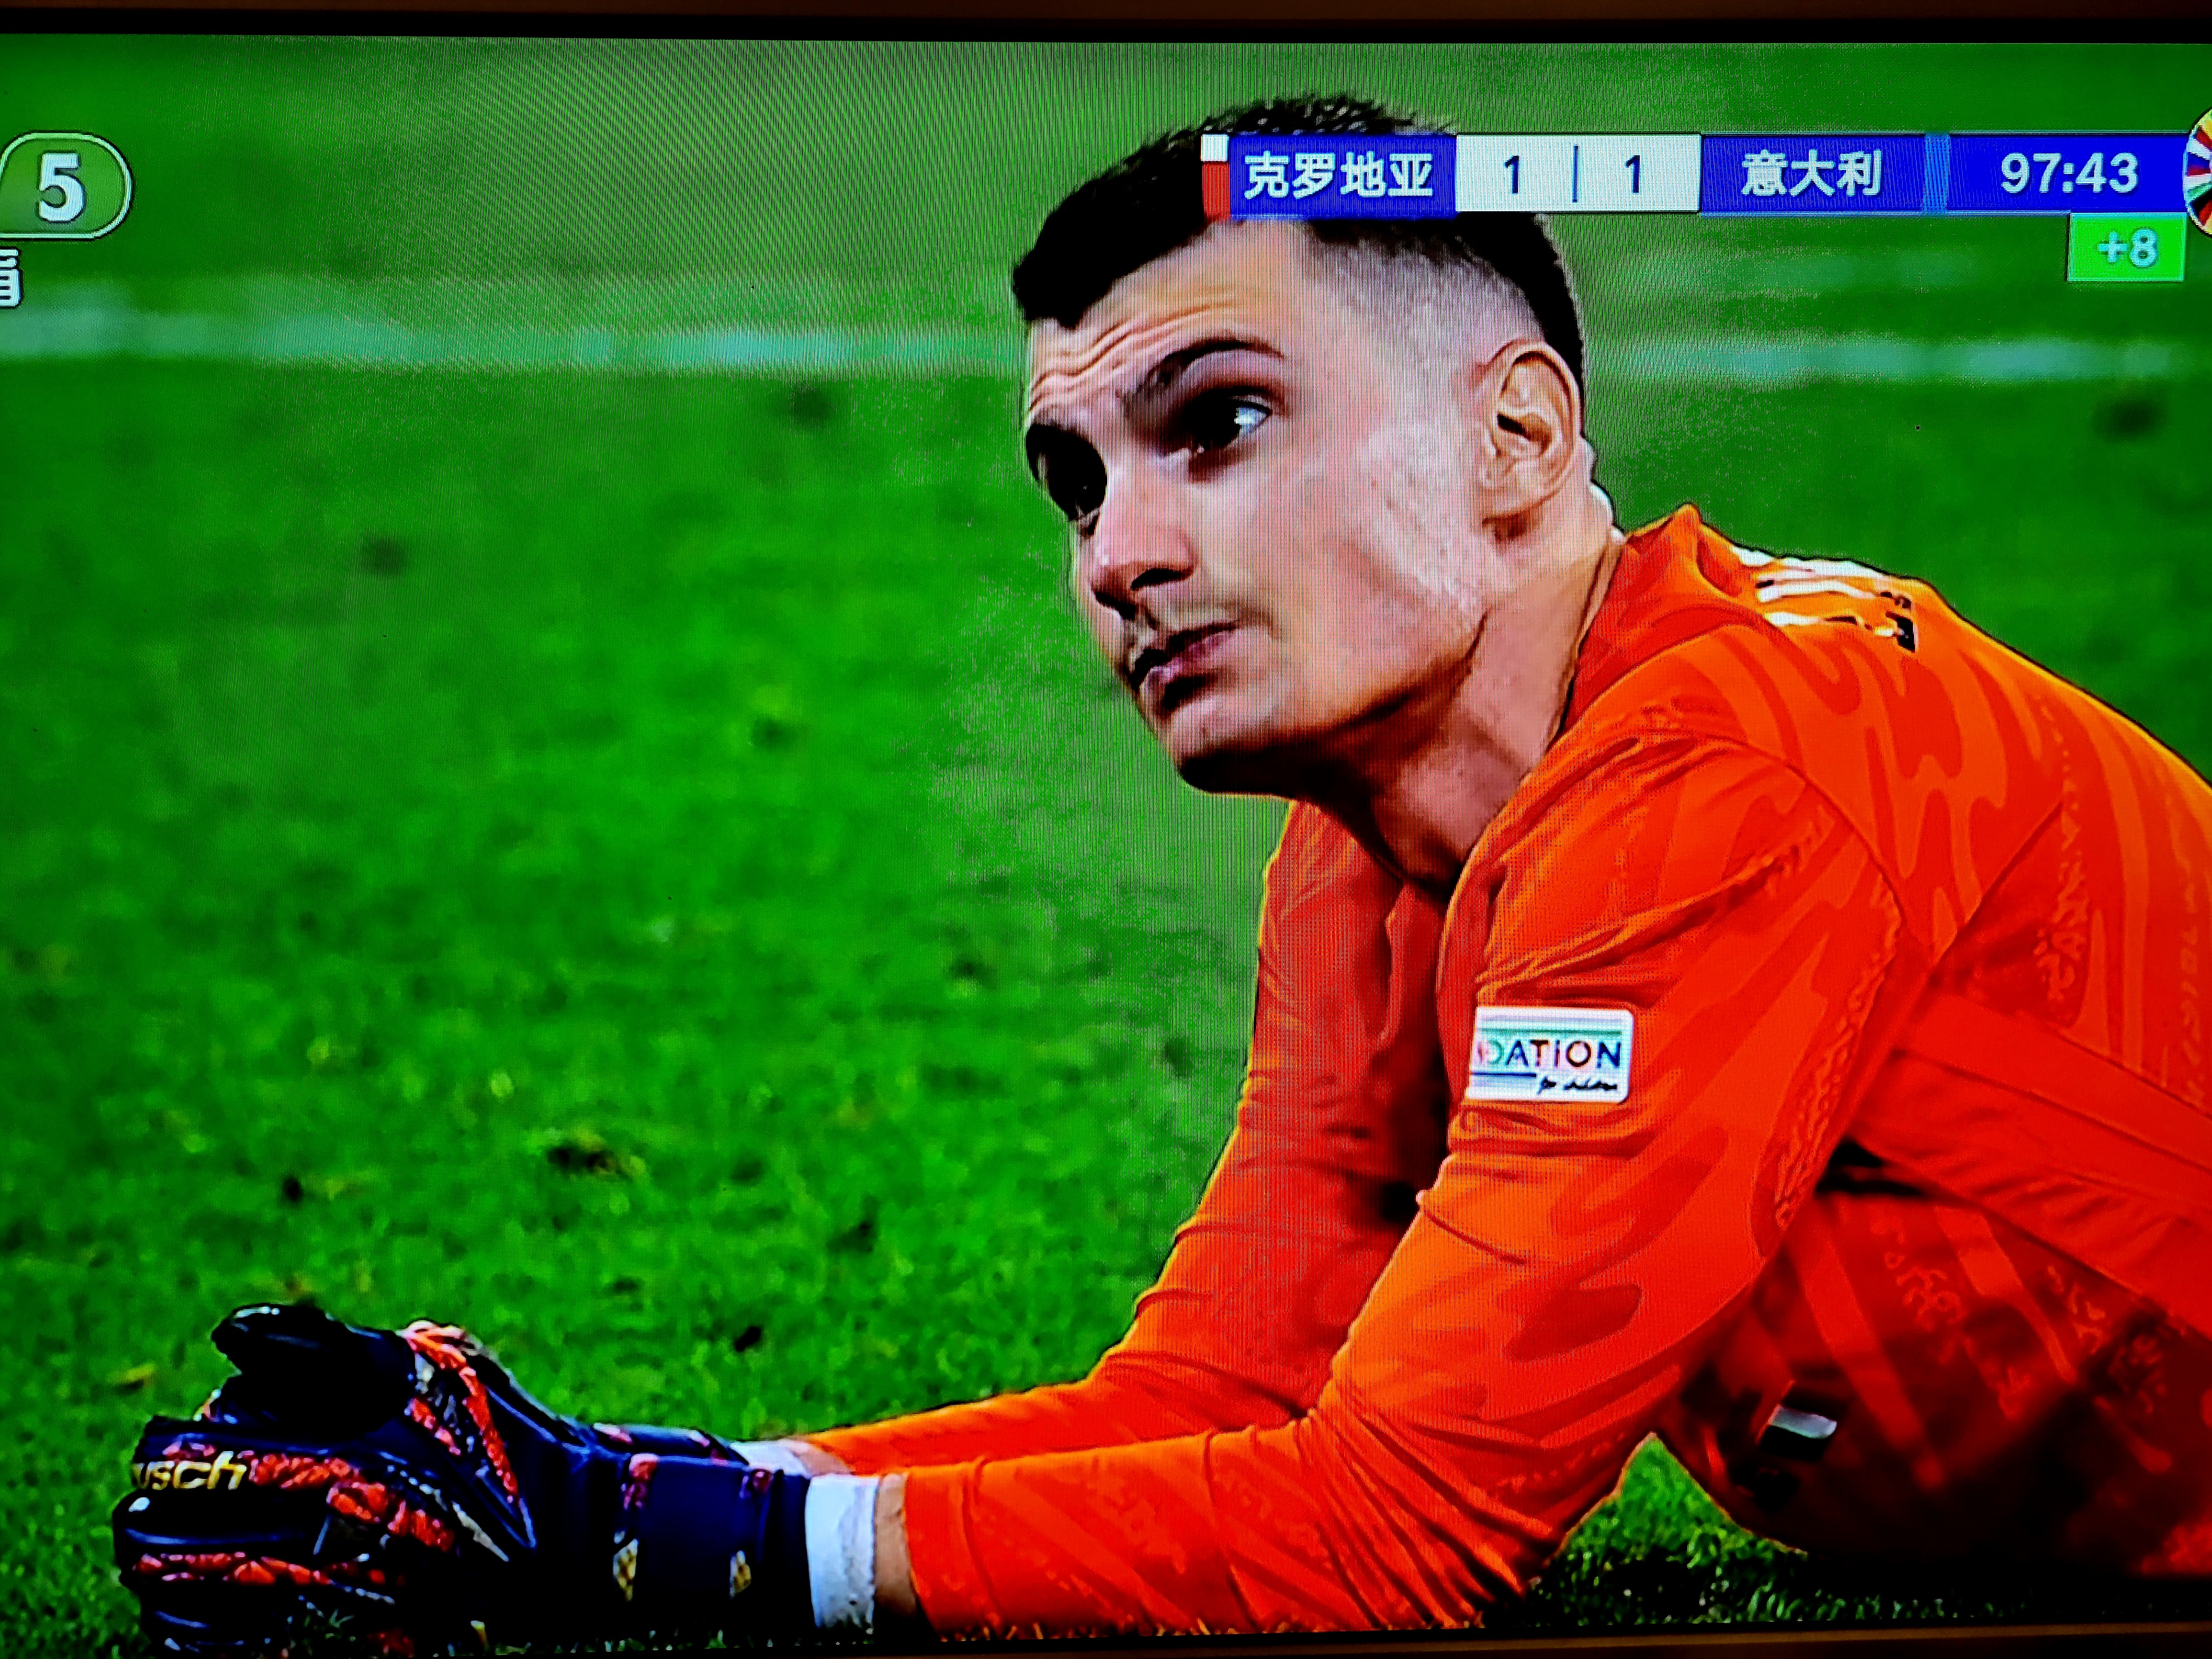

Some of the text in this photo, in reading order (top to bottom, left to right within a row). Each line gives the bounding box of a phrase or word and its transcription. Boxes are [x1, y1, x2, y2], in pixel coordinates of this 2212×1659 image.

[38, 151, 85, 223] 5
[1243, 150, 1434, 200] 克罗地亚
[1504, 154, 1520, 195] 1
[1625, 154, 1641, 195] 1
[1741, 149, 1882, 197] 意大利
[2000, 152, 2139, 194] 97:43
[2097, 228, 2158, 268] +8
